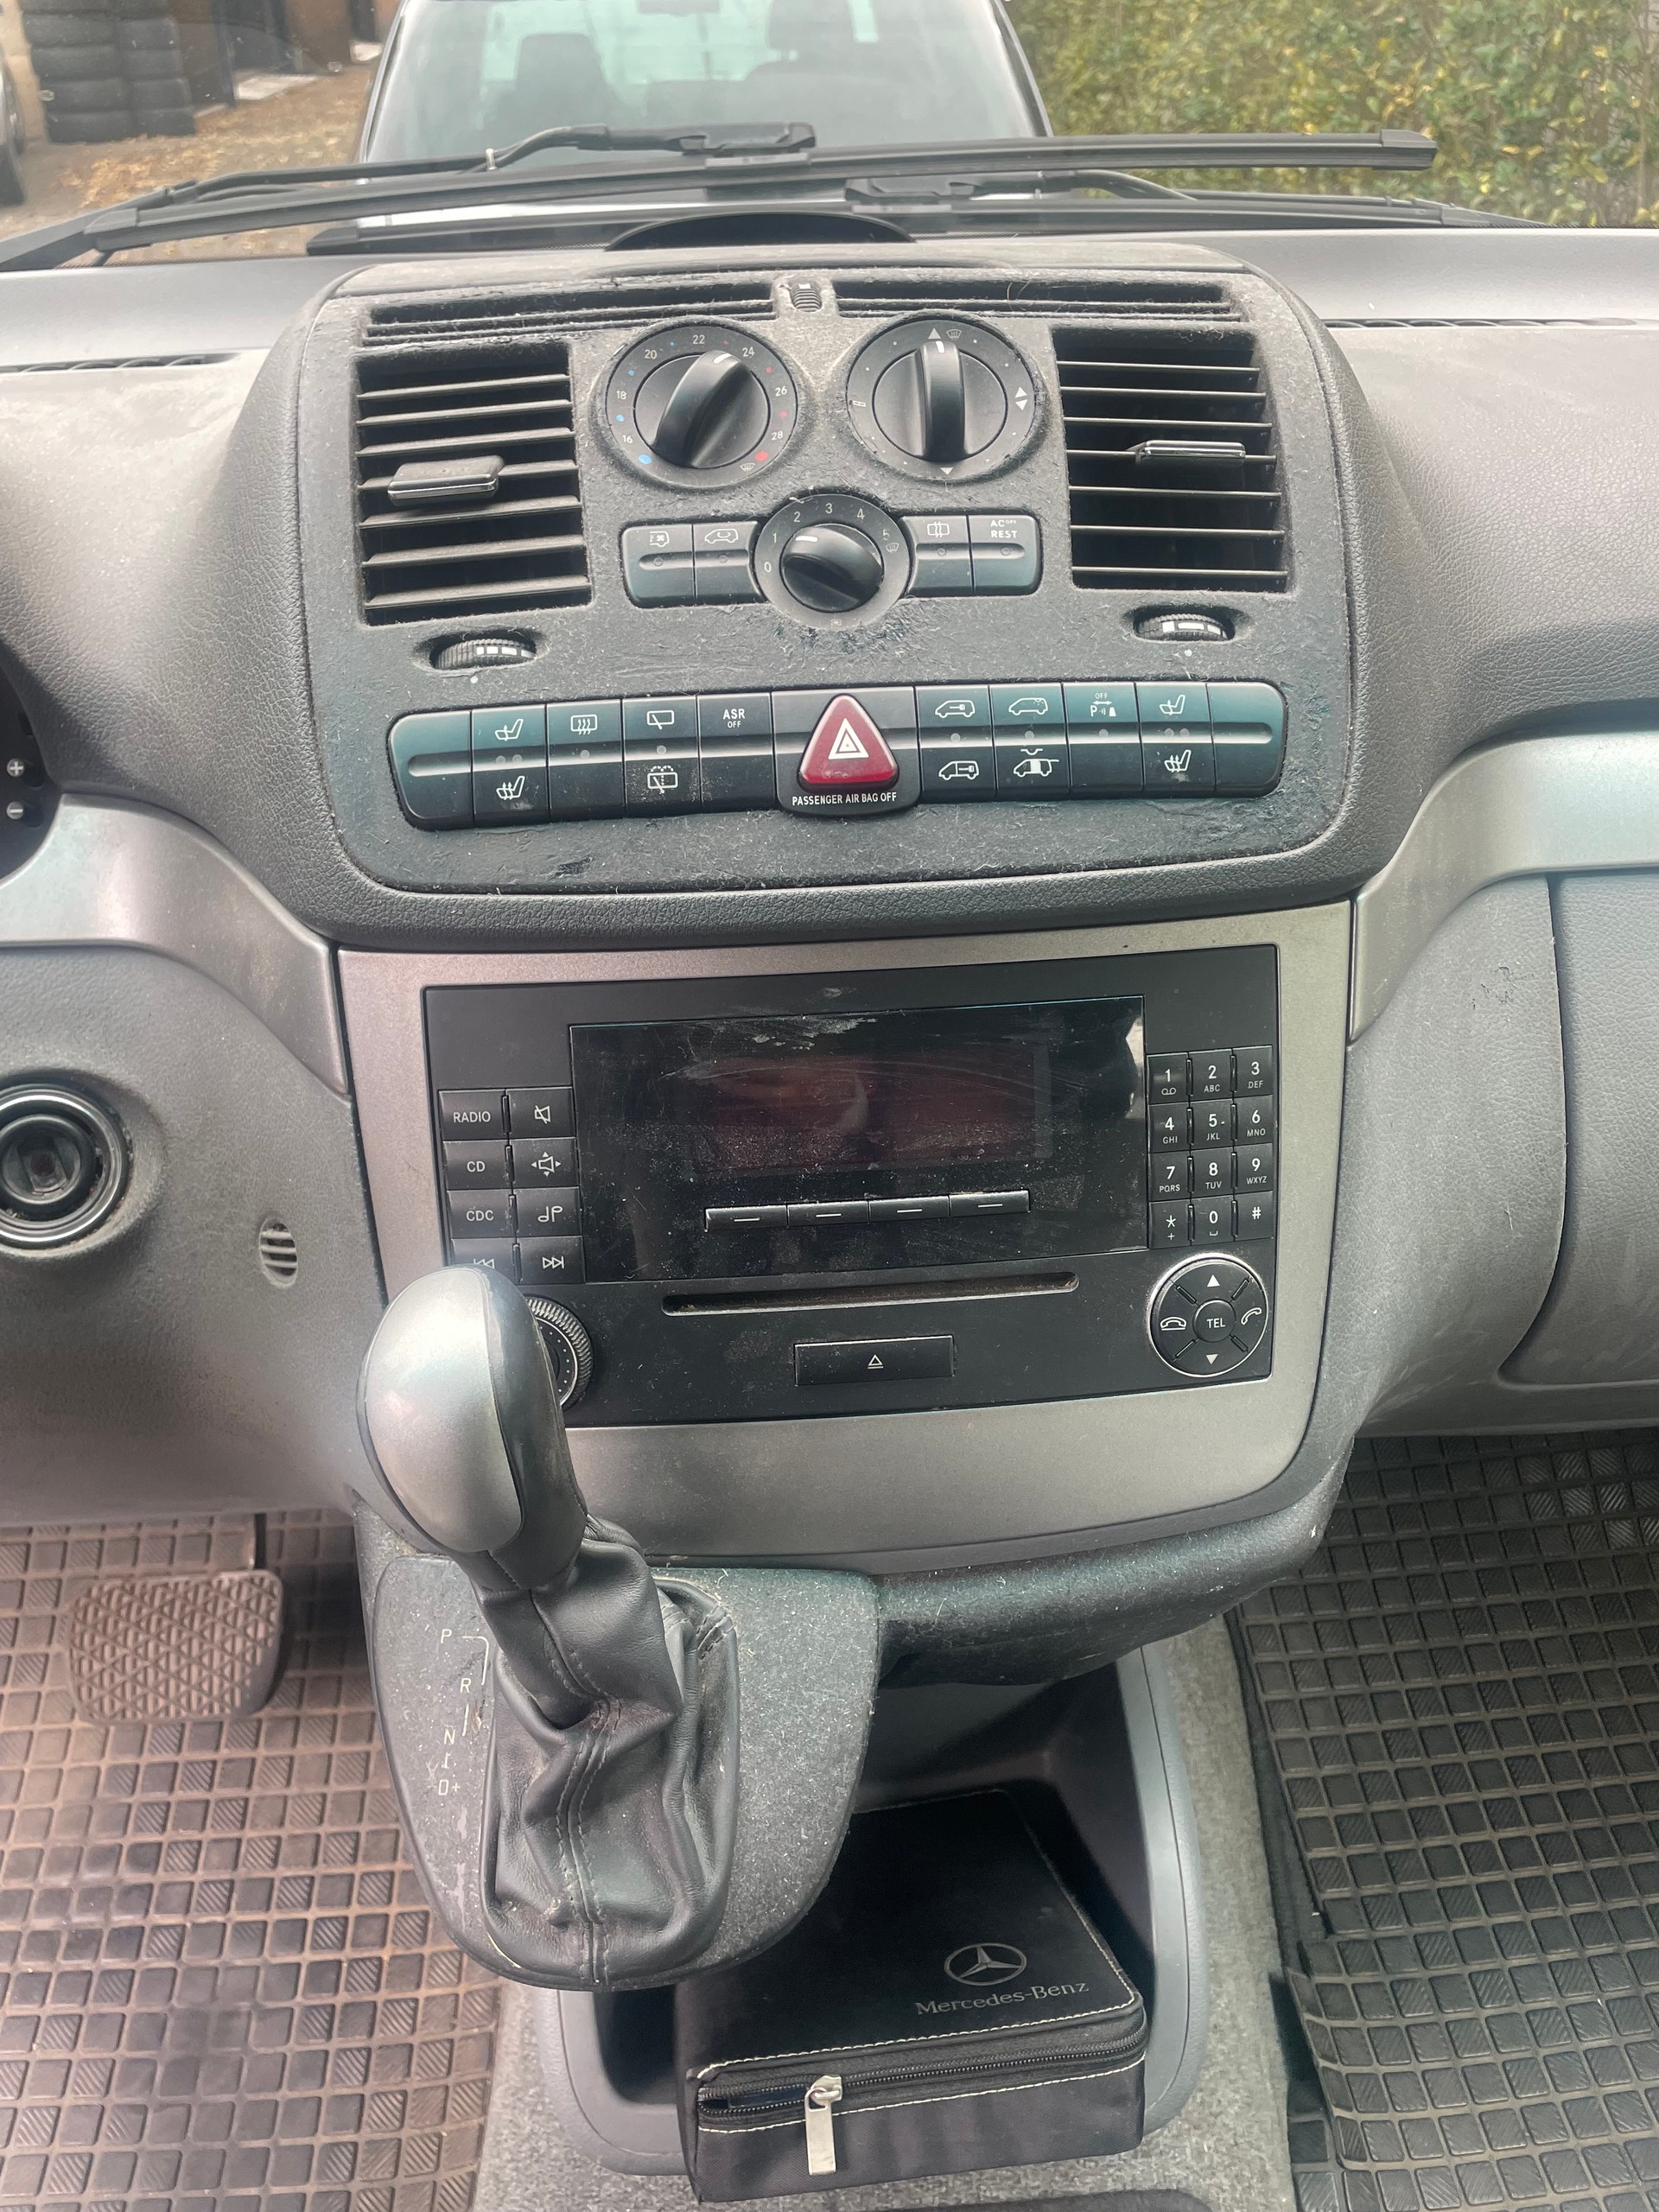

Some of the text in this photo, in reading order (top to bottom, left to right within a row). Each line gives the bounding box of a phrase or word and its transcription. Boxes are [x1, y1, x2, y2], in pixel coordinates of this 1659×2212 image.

[692, 334, 706, 345] 22
[645, 349, 658, 359] 20
[742, 346, 755, 358] 24
[616, 390, 627, 400] 18
[774, 386, 788, 397] 26
[622, 435, 633, 444] 16
[772, 430, 784, 441] 28
[825, 502, 833, 514] 3
[856, 508, 865, 520] 4
[793, 511, 801, 523] 2
[772, 532, 778, 543] 1
[882, 529, 891, 541] 5
[990, 530, 1018, 538] REST
[764, 562, 772, 573] 0
[722, 708, 746, 720] ASR
[791, 791, 897, 806] PASSENGER AIR BAG OFF
[1208, 1065, 1217, 1080] 2
[1251, 1061, 1260, 1076] 3
[1165, 1068, 1171, 1083] 1
[1204, 1084, 1221, 1093] ABC
[1248, 1080, 1264, 1090] DEF
[453, 1110, 492, 1123] RADIO
[1209, 1114, 1217, 1128] 5
[1252, 1109, 1261, 1124] 6
[1165, 1116, 1174, 1131] 4
[1206, 1132, 1221, 1141] JKL
[1247, 1128, 1266, 1137] MNO
[1162, 1135, 1178, 1144] GHI
[467, 1160, 486, 1173] CD
[1209, 1162, 1218, 1176] 8
[1252, 1158, 1261, 1172] 9
[1166, 1166, 1176, 1179] 7
[1205, 1181, 1223, 1190] TUV
[1246, 1175, 1268, 1185] WXYZ
[1159, 1184, 1181, 1193] PQRS
[466, 1210, 494, 1222] CDC
[1210, 1211, 1218, 1224] 0
[1206, 1317, 1226, 1329] TEL
[440, 1628, 453, 1643] P
[460, 1677, 472, 1694] R
[443, 1729, 455, 1745] N
[914, 1982, 1090, 2015] Mercedes-Benz
